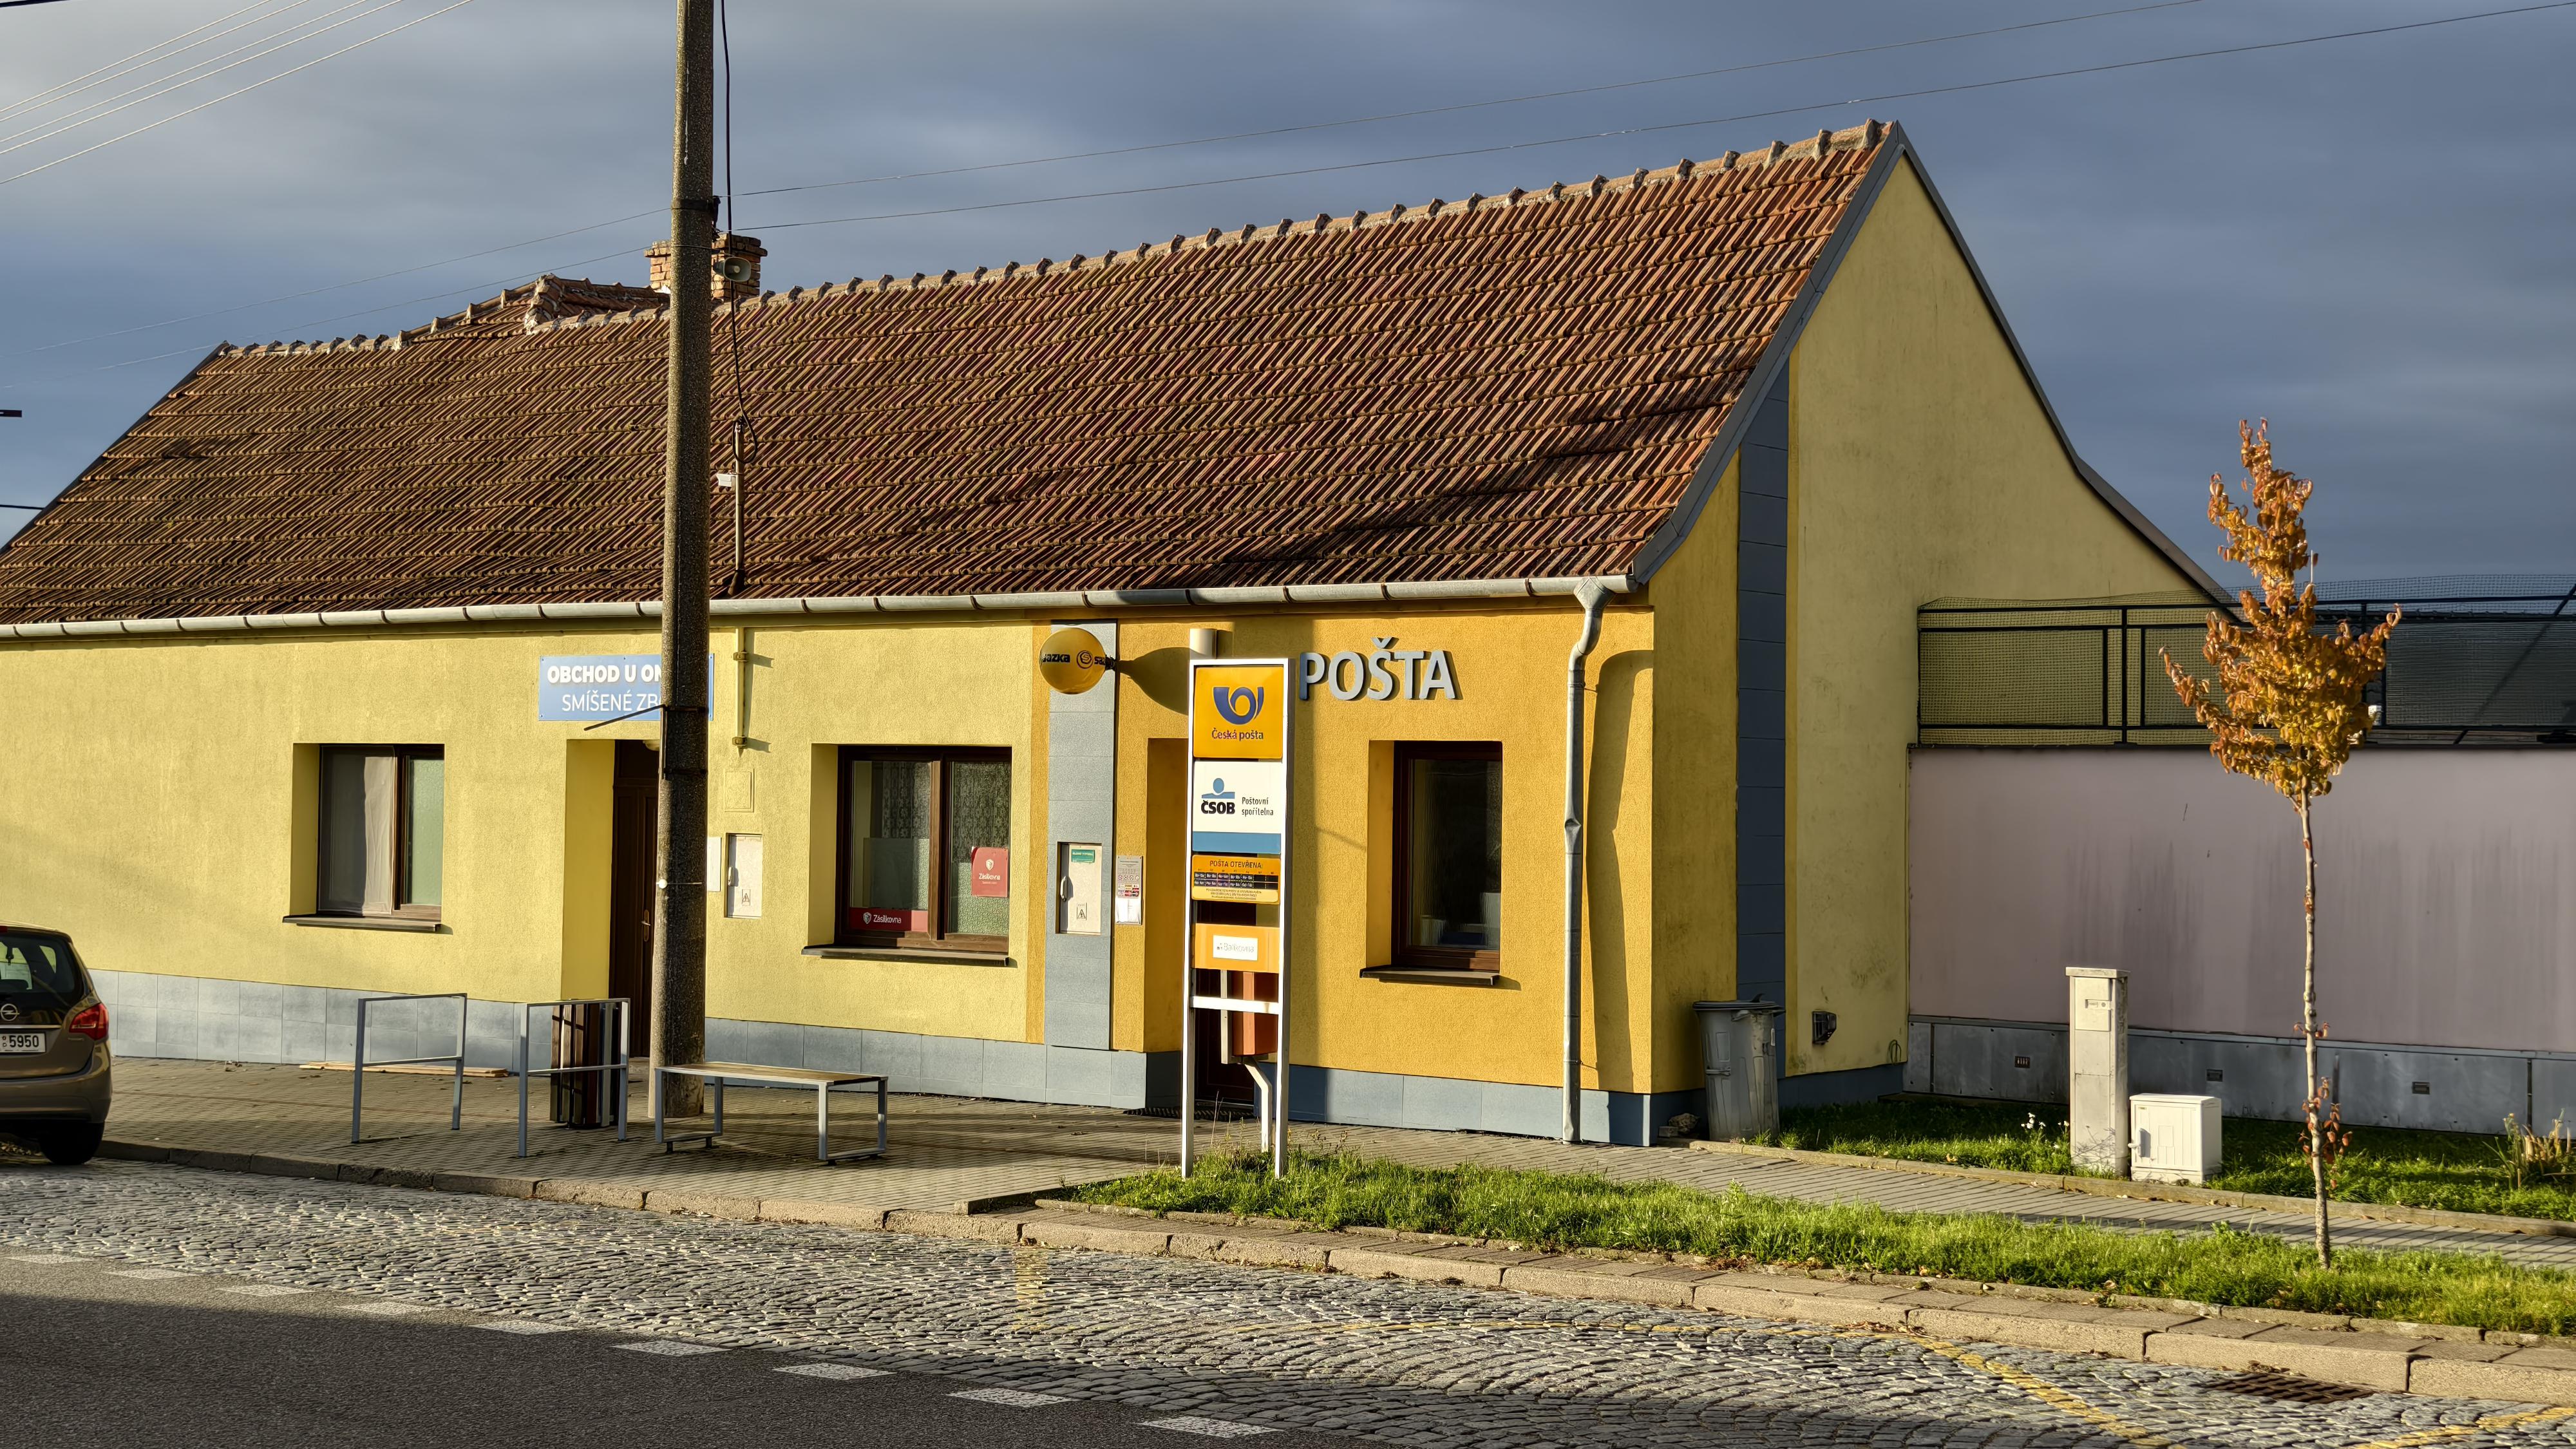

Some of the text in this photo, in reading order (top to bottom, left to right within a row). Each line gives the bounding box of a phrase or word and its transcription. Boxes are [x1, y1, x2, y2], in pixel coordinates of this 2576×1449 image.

[547, 665, 620, 683] OBCHOD
[624, 665, 637, 683] U
[1299, 636, 1455, 700] POŠTA
[562, 689, 661, 712] SMÍŠENÉ ZB
[1211, 728, 1264, 741] Česká pošta
[1200, 800, 1235, 815] ČSOB
[1242, 797, 1269, 805] Poštovní
[1242, 808, 1274, 817] spořitelna
[979, 872, 1001, 880] Zásilkovna
[873, 914, 902, 924] Zásilkovna
[9, 1035, 39, 1048] 5950
